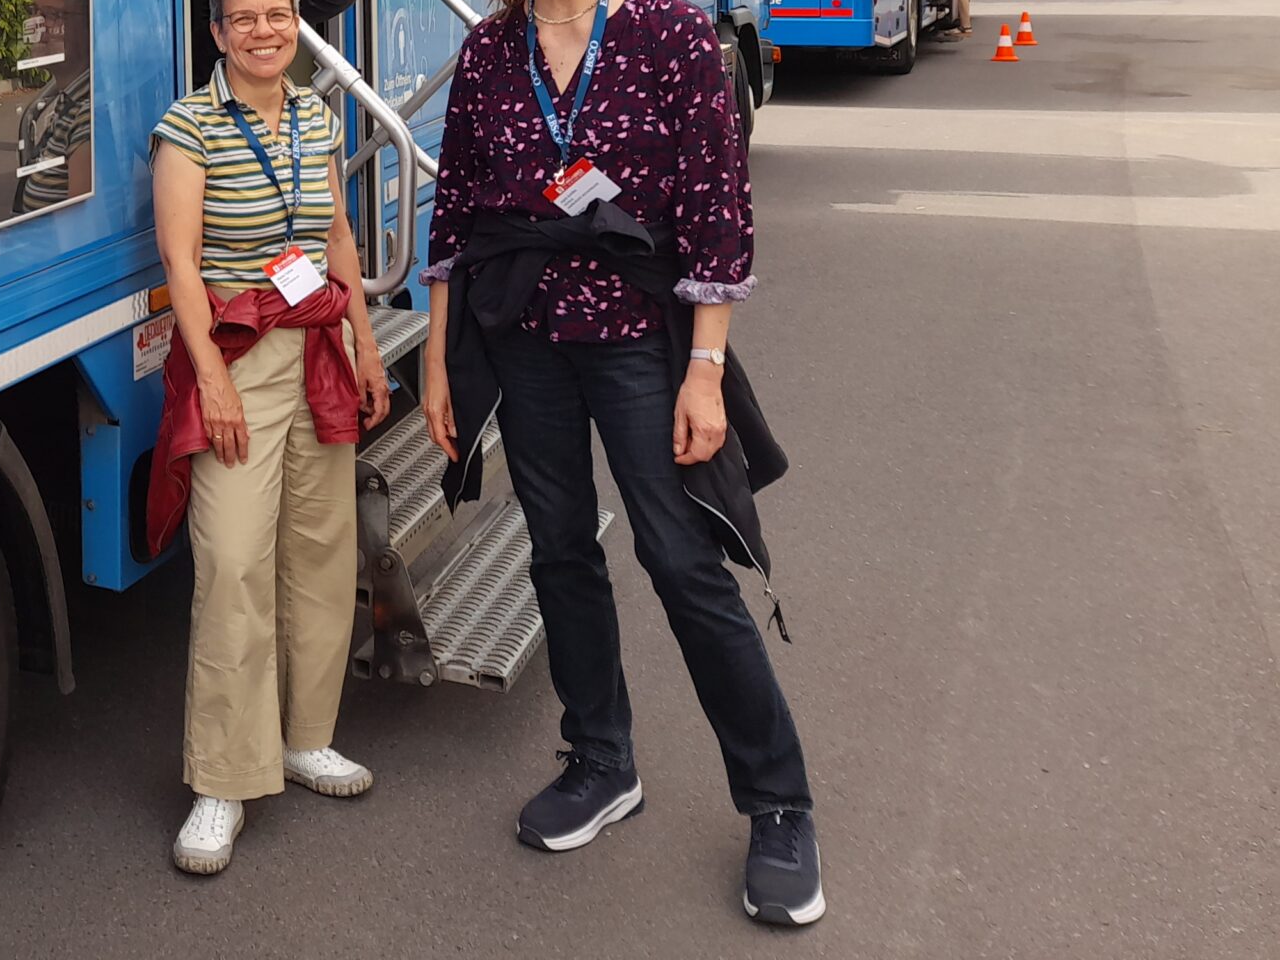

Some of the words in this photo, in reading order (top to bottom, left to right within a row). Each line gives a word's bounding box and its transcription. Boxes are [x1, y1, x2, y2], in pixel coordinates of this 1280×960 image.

[583, 40, 599, 75] EBSCO
[546, 113, 564, 144] EBSCO
[291, 129, 301, 160] EBSCO
